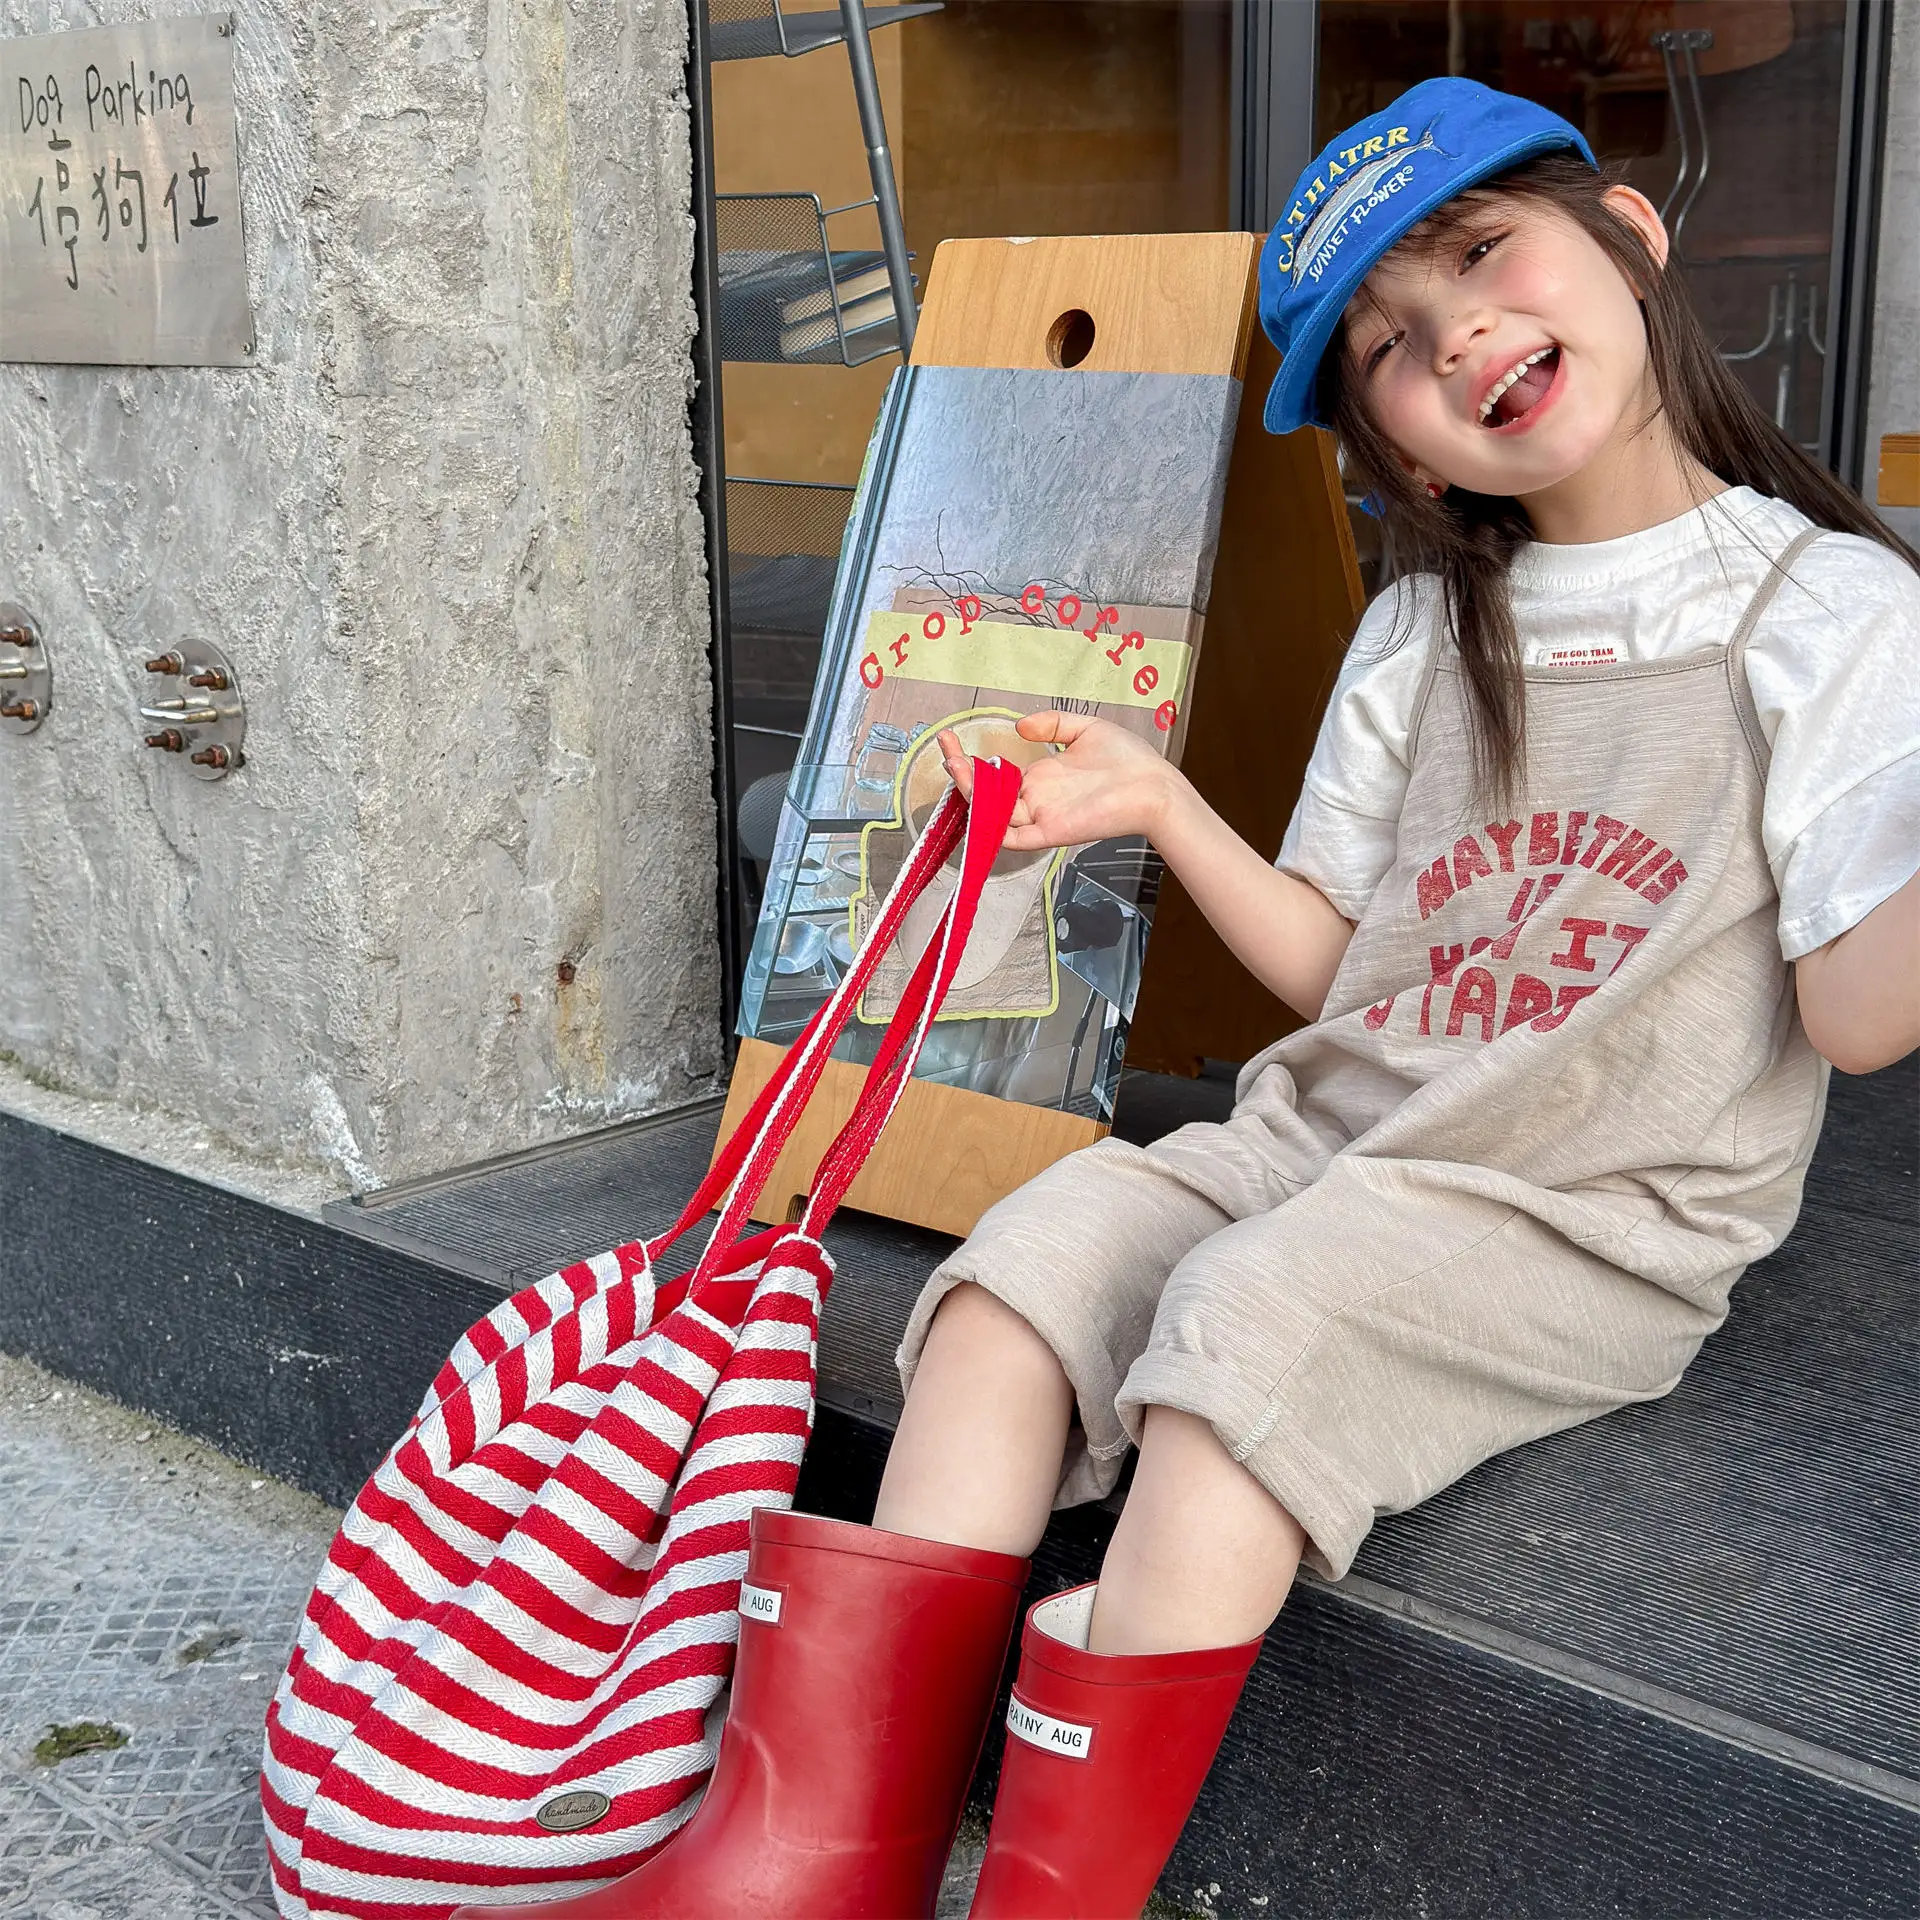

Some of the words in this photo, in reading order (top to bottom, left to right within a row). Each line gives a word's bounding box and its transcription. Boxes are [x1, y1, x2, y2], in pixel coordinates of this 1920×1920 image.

[19, 74, 63, 133] Dog
[86, 61, 193, 132] Parking
[1309, 217, 1350, 283] SUNSET
[1021, 585, 1177, 731] coffee
[1551, 651, 1569, 660] THE
[751, 1595, 774, 1613] AUG
[1008, 1703, 1043, 1735] RAINY
[1051, 1728, 1083, 1747] AUG
[544, 1799, 598, 1818] handmade
